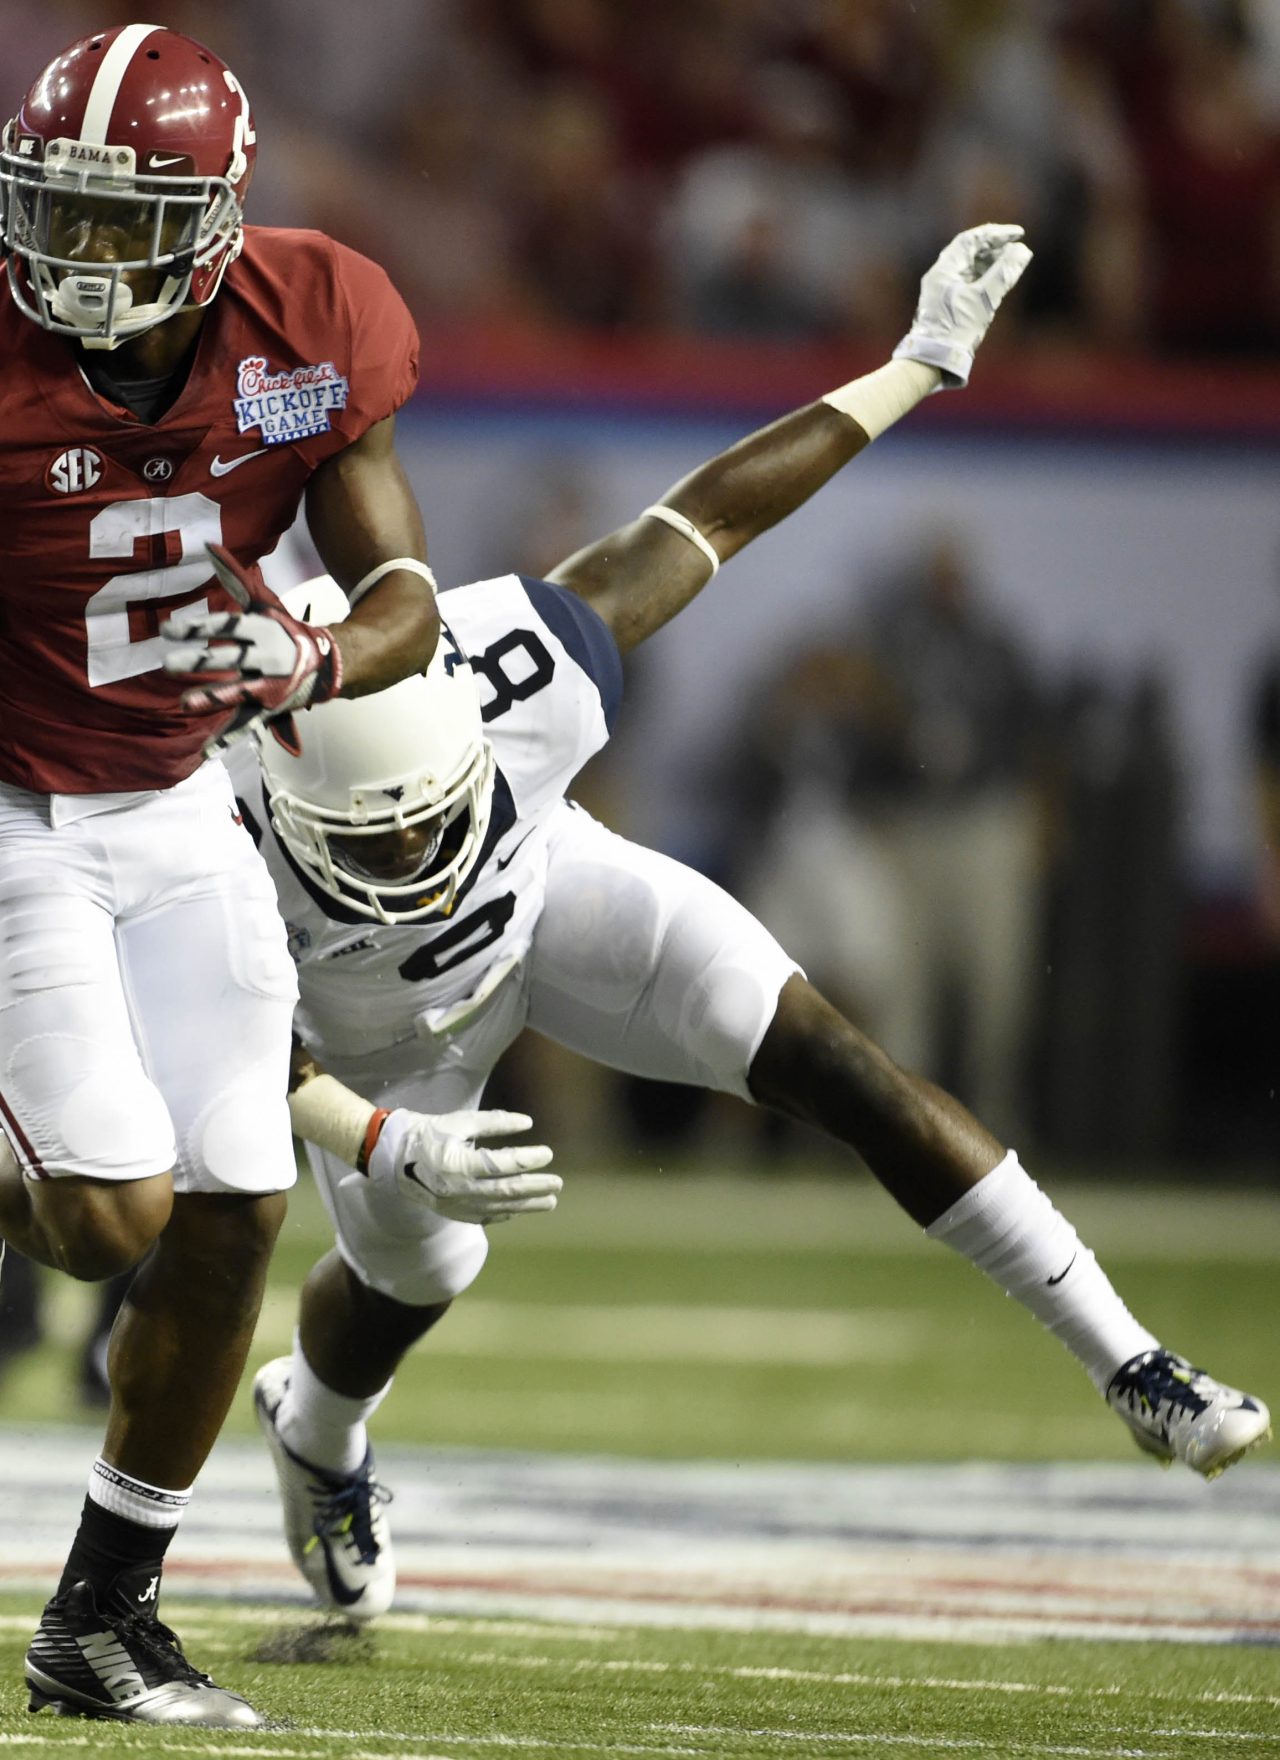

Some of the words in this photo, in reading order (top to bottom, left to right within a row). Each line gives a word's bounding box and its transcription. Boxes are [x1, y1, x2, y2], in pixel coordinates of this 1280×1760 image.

[69, 146, 111, 164] BAMA
[239, 383, 342, 425] KICKOFF
[265, 410, 324, 433] GAME
[50, 448, 102, 493] SEC
[85, 492, 223, 687] 2
[468, 628, 556, 723] 8
[75, 1630, 148, 1703] NIKE
